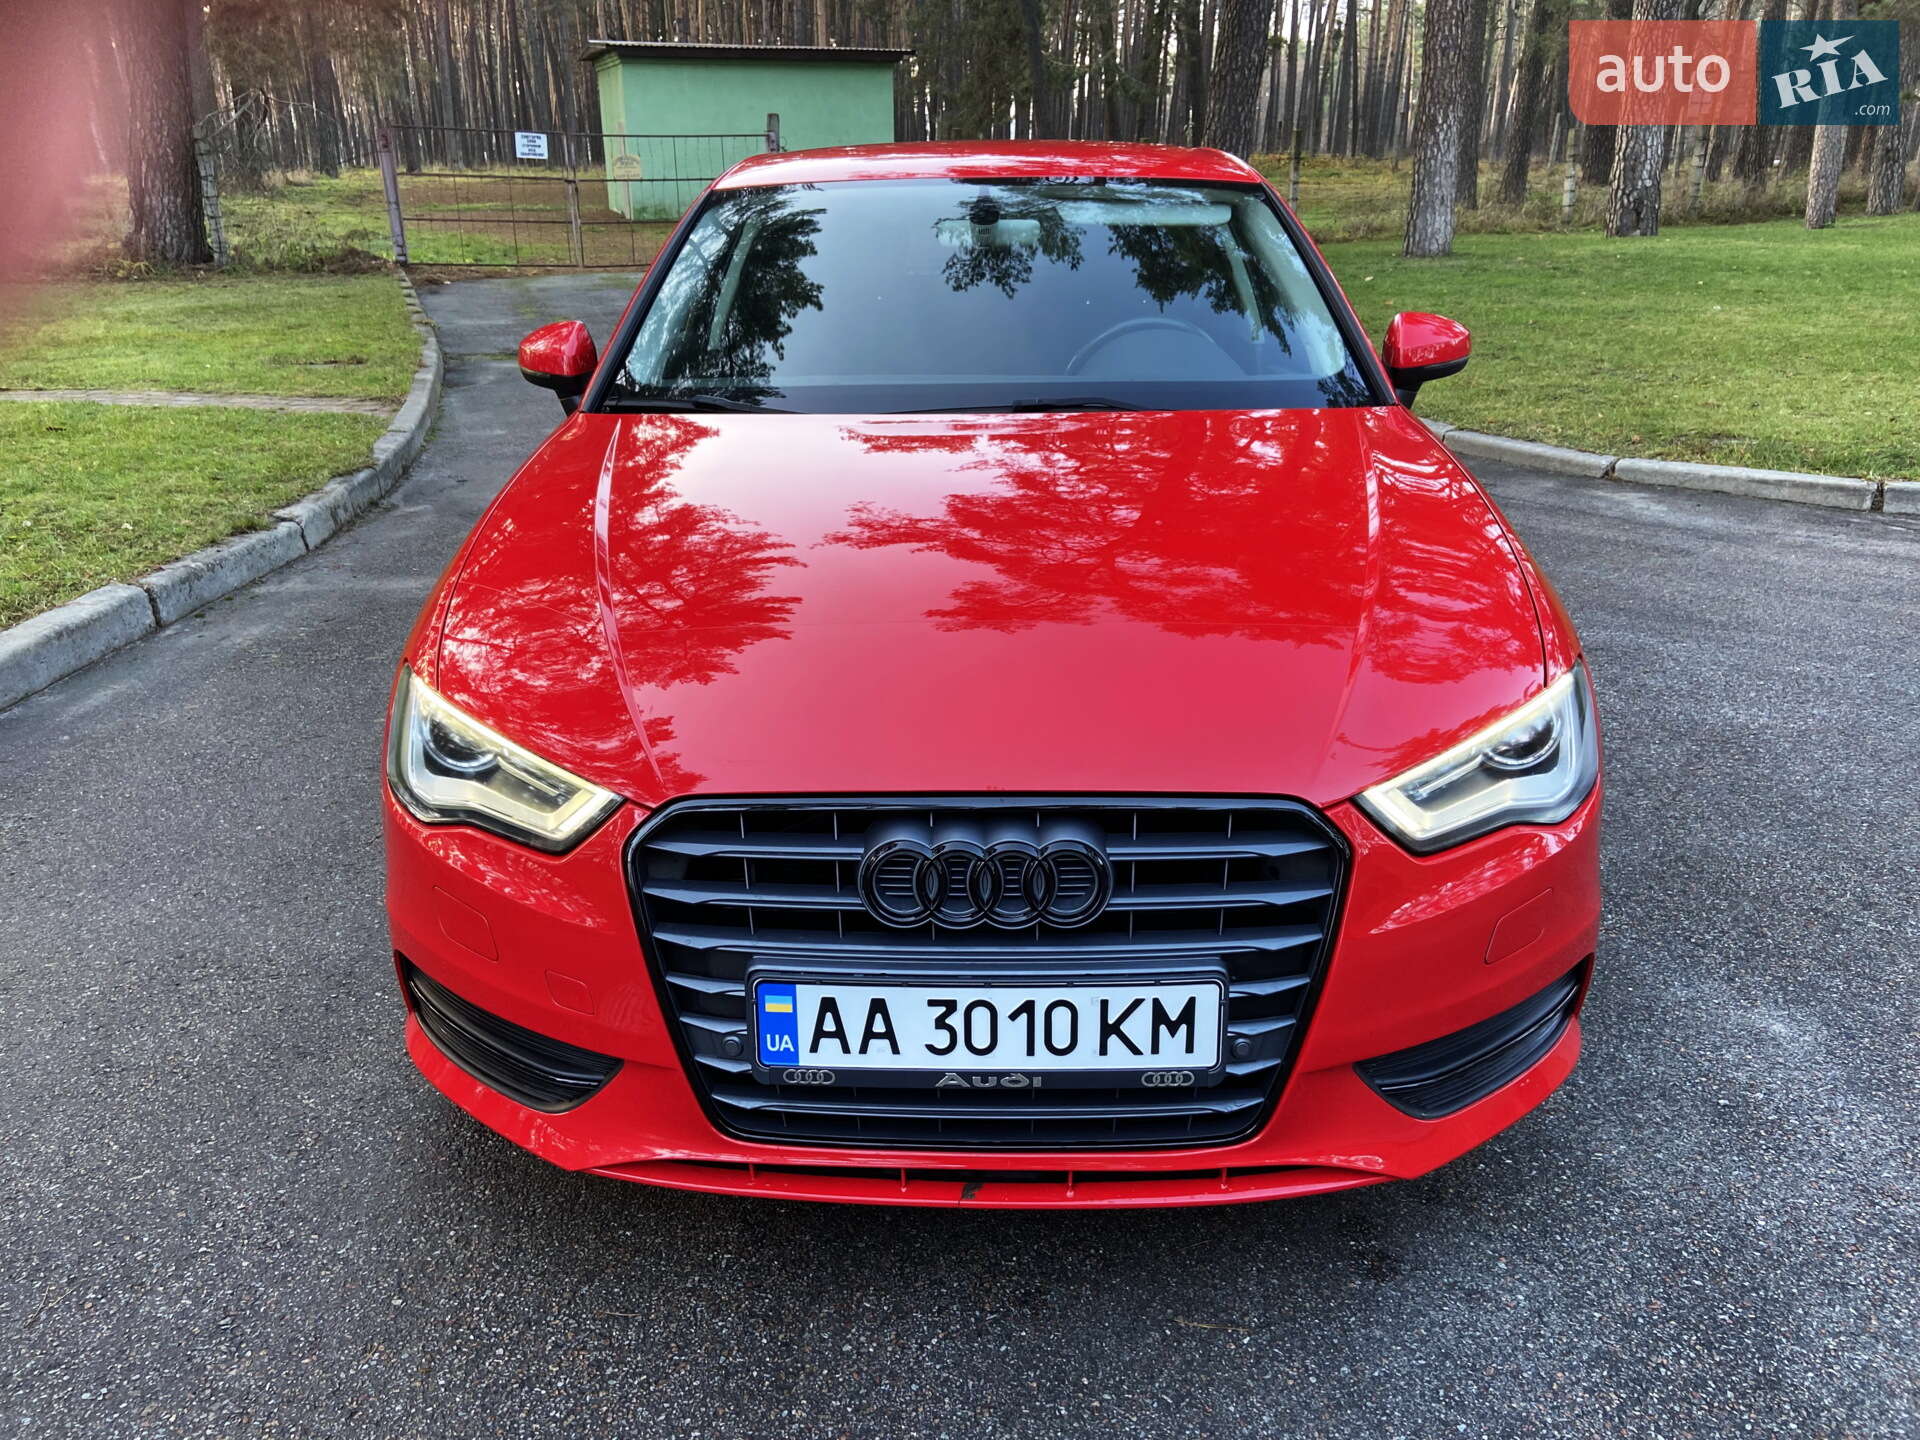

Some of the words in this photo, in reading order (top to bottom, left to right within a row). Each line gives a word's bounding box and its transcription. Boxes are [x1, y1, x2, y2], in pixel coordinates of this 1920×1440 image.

[809, 996, 901, 1055] AA
[925, 999, 1079, 1057] 3010
[1098, 996, 1196, 1056] KM
[766, 1033, 795, 1052] UA
[935, 1072, 1042, 1088] Audi
